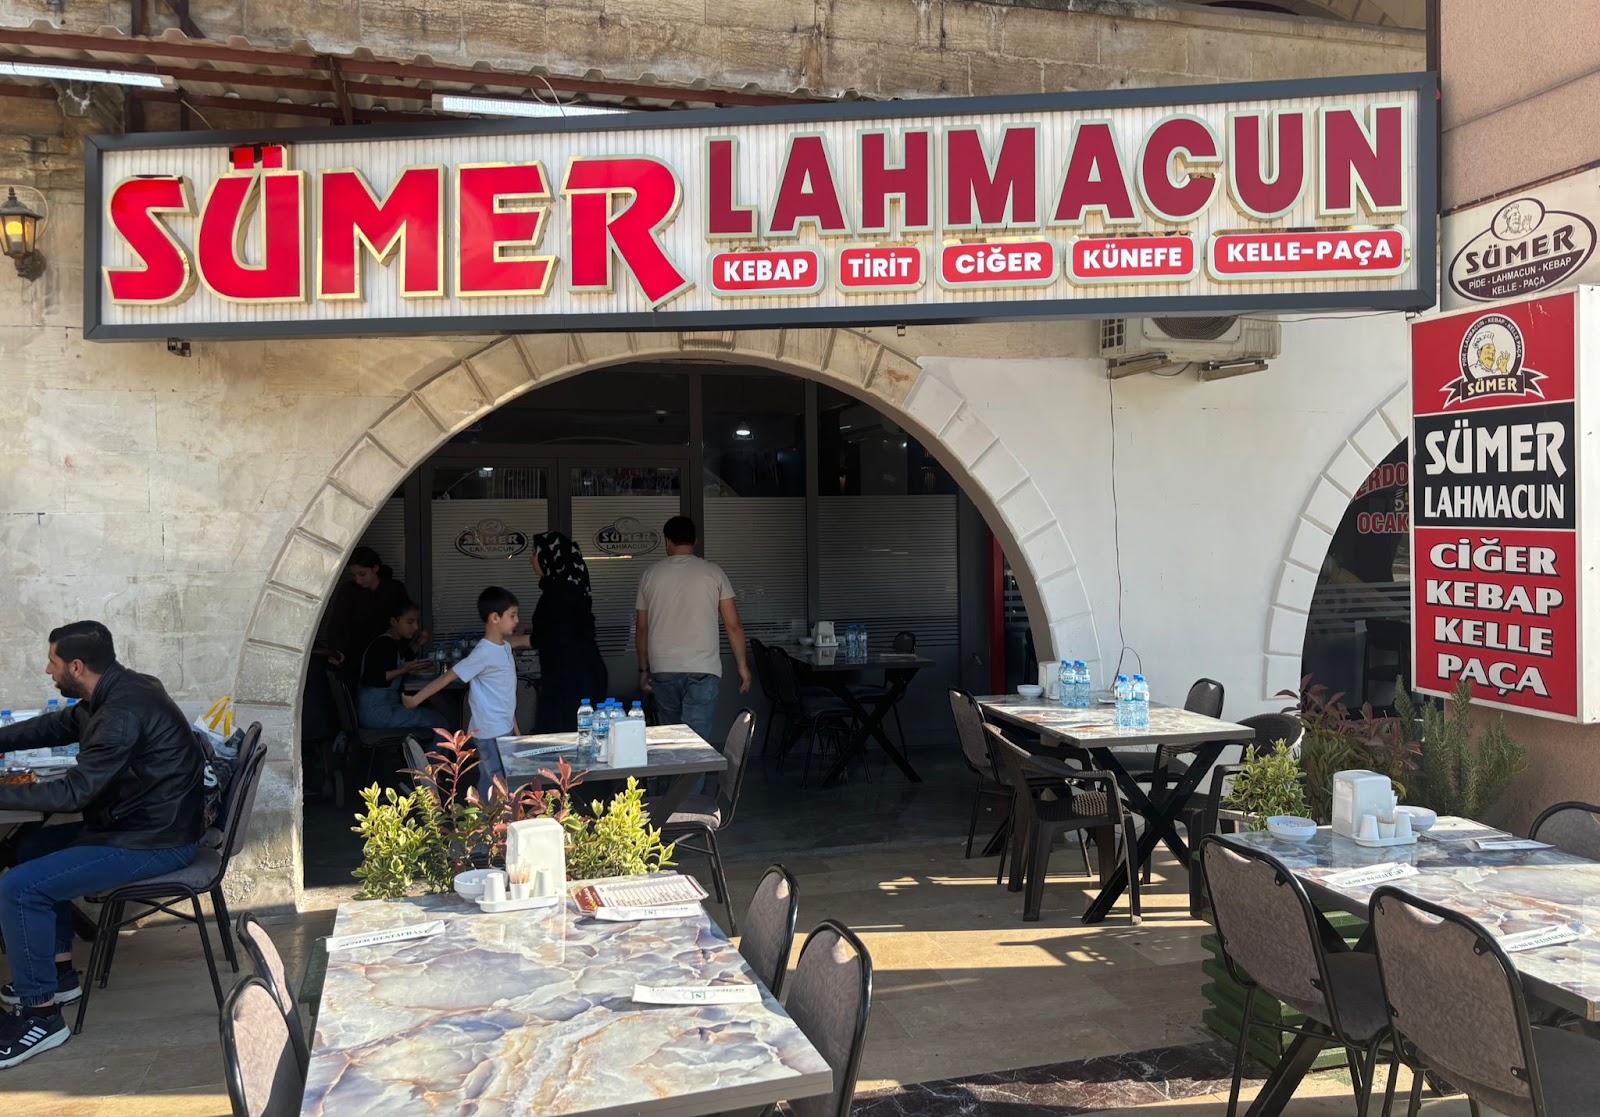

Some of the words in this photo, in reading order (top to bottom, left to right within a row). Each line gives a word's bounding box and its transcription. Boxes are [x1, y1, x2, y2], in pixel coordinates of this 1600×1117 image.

[704, 101, 1408, 240] LAHMACUN
[103, 142, 697, 311] SÜMER
[848, 252, 913, 278] TİRİT
[955, 246, 1043, 274] CİĞER
[1083, 243, 1182, 269] KÜNEFE
[1227, 239, 1393, 266] KELLE-PAÇA
[1465, 224, 1575, 275] SÜMER
[723, 258, 809, 282] KEBAP
[1468, 278, 1486, 290] PİDE
[1492, 266, 1536, 284] LAHMACUN
[1542, 256, 1572, 272] KEBAP
[1492, 283, 1517, 296] KELLE
[1523, 276, 1546, 289] PAÇA
[1467, 377, 1517, 396] SÜMER
[1424, 419, 1567, 478] SÜMER
[1424, 484, 1564, 519] LAHMACUN
[1429, 537, 1559, 576] CİĞER
[1426, 579, 1563, 616] KEBAP
[1434, 616, 1553, 656] KELLE
[1437, 653, 1550, 697] PAÇA
